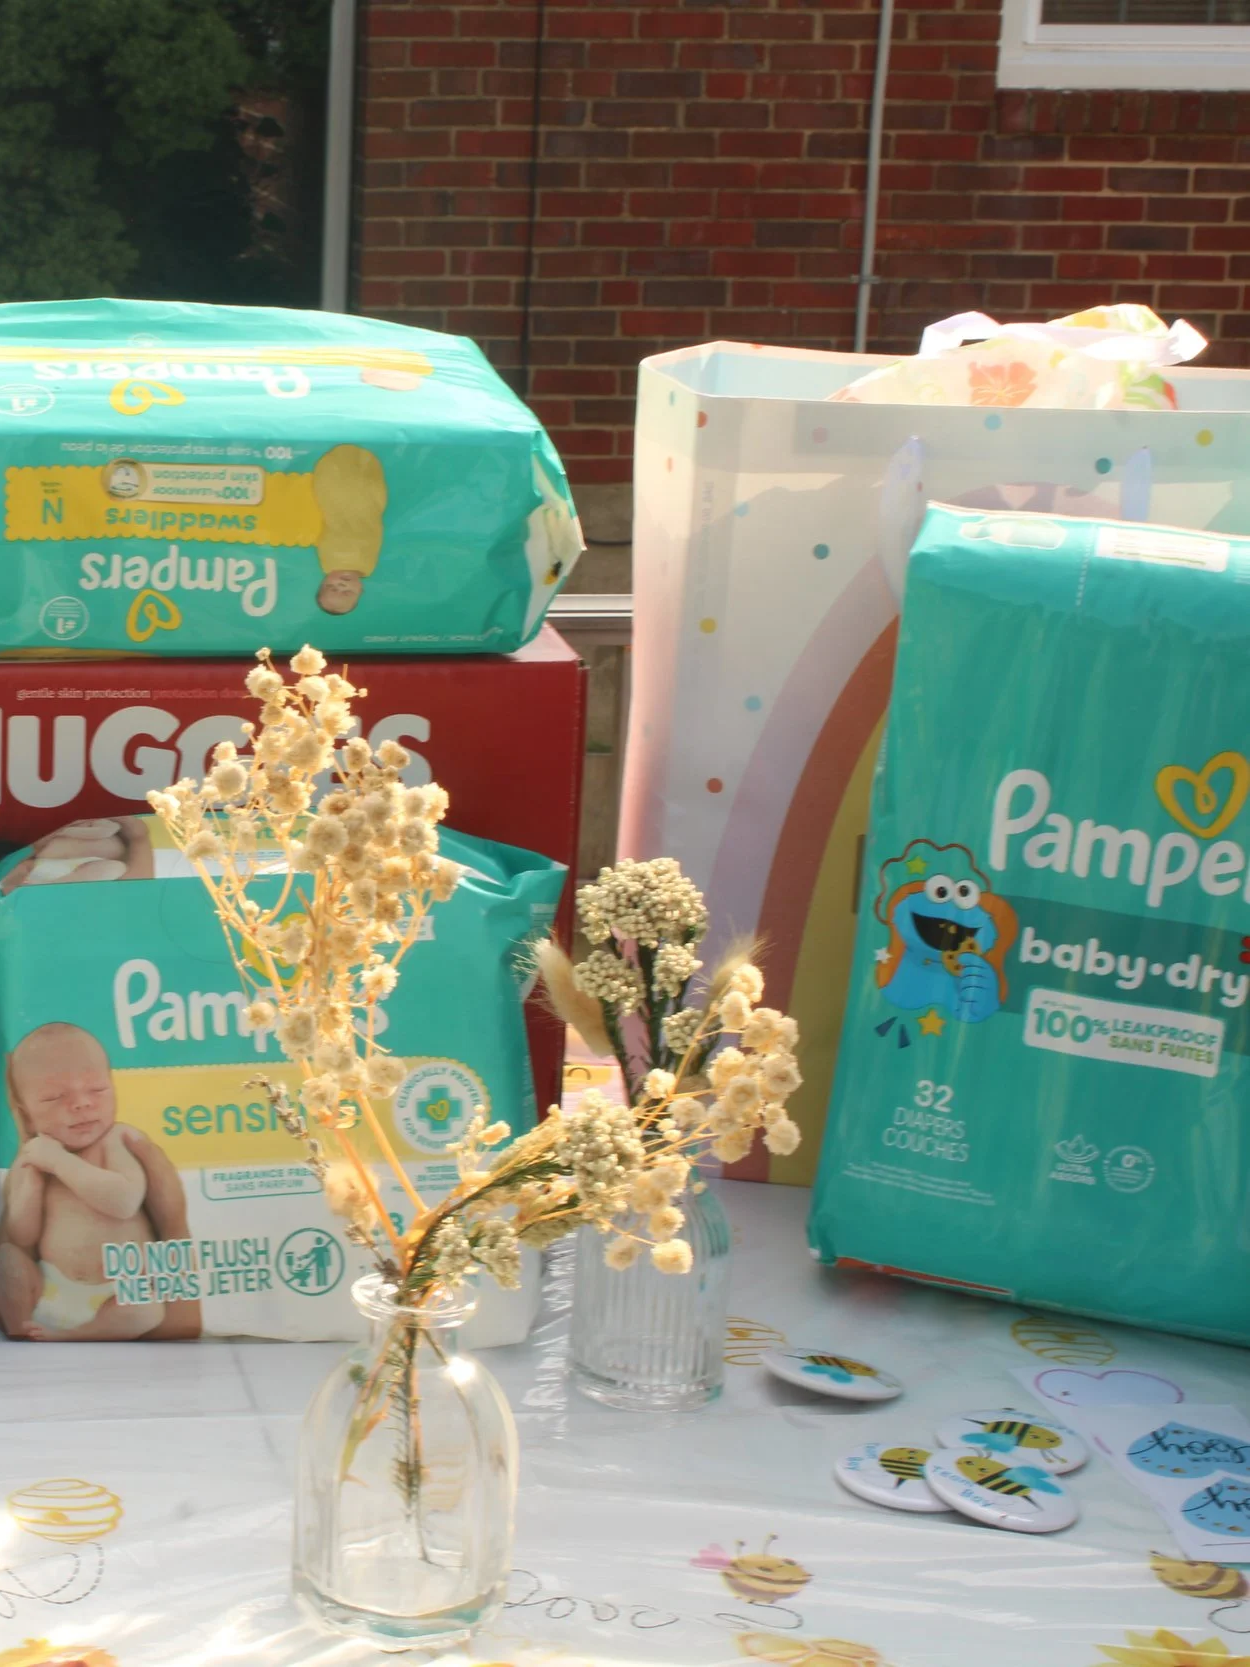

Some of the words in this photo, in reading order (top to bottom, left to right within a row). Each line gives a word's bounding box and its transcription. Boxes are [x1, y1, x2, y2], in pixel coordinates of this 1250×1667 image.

[36, 361, 312, 398] Pampers
[151, 469, 228, 484] protection
[42, 497, 64, 525] N
[104, 507, 258, 533] swaddlers
[80, 545, 278, 617] Pampers
[16, 687, 56, 701] gentle
[57, 687, 83, 699] skin
[85, 687, 151, 701] protection
[988, 768, 1250, 909] Pampe
[113, 958, 390, 1053] Pamps
[1108, 1034, 1155, 1054] SANS
[1157, 1041, 1216, 1065] FUITES
[1111, 1018, 1219, 1047] LEAKPROOF
[161, 1087, 364, 1137] sensie
[913, 1079, 954, 1113] 32
[893, 1106, 967, 1140] DIAPERS
[881, 1126, 970, 1163] COUCHES
[211, 1168, 285, 1182] FRAGRANCE
[225, 1181, 257, 1193] SANS
[257, 1179, 305, 1190] PARFUM
[104, 1242, 141, 1277] DO
[145, 1240, 193, 1274] NOT
[199, 1237, 271, 1270] FLUSH
[117, 1276, 150, 1304] NE
[156, 1273, 200, 1300] PAS
[206, 1267, 274, 1297] JETER
